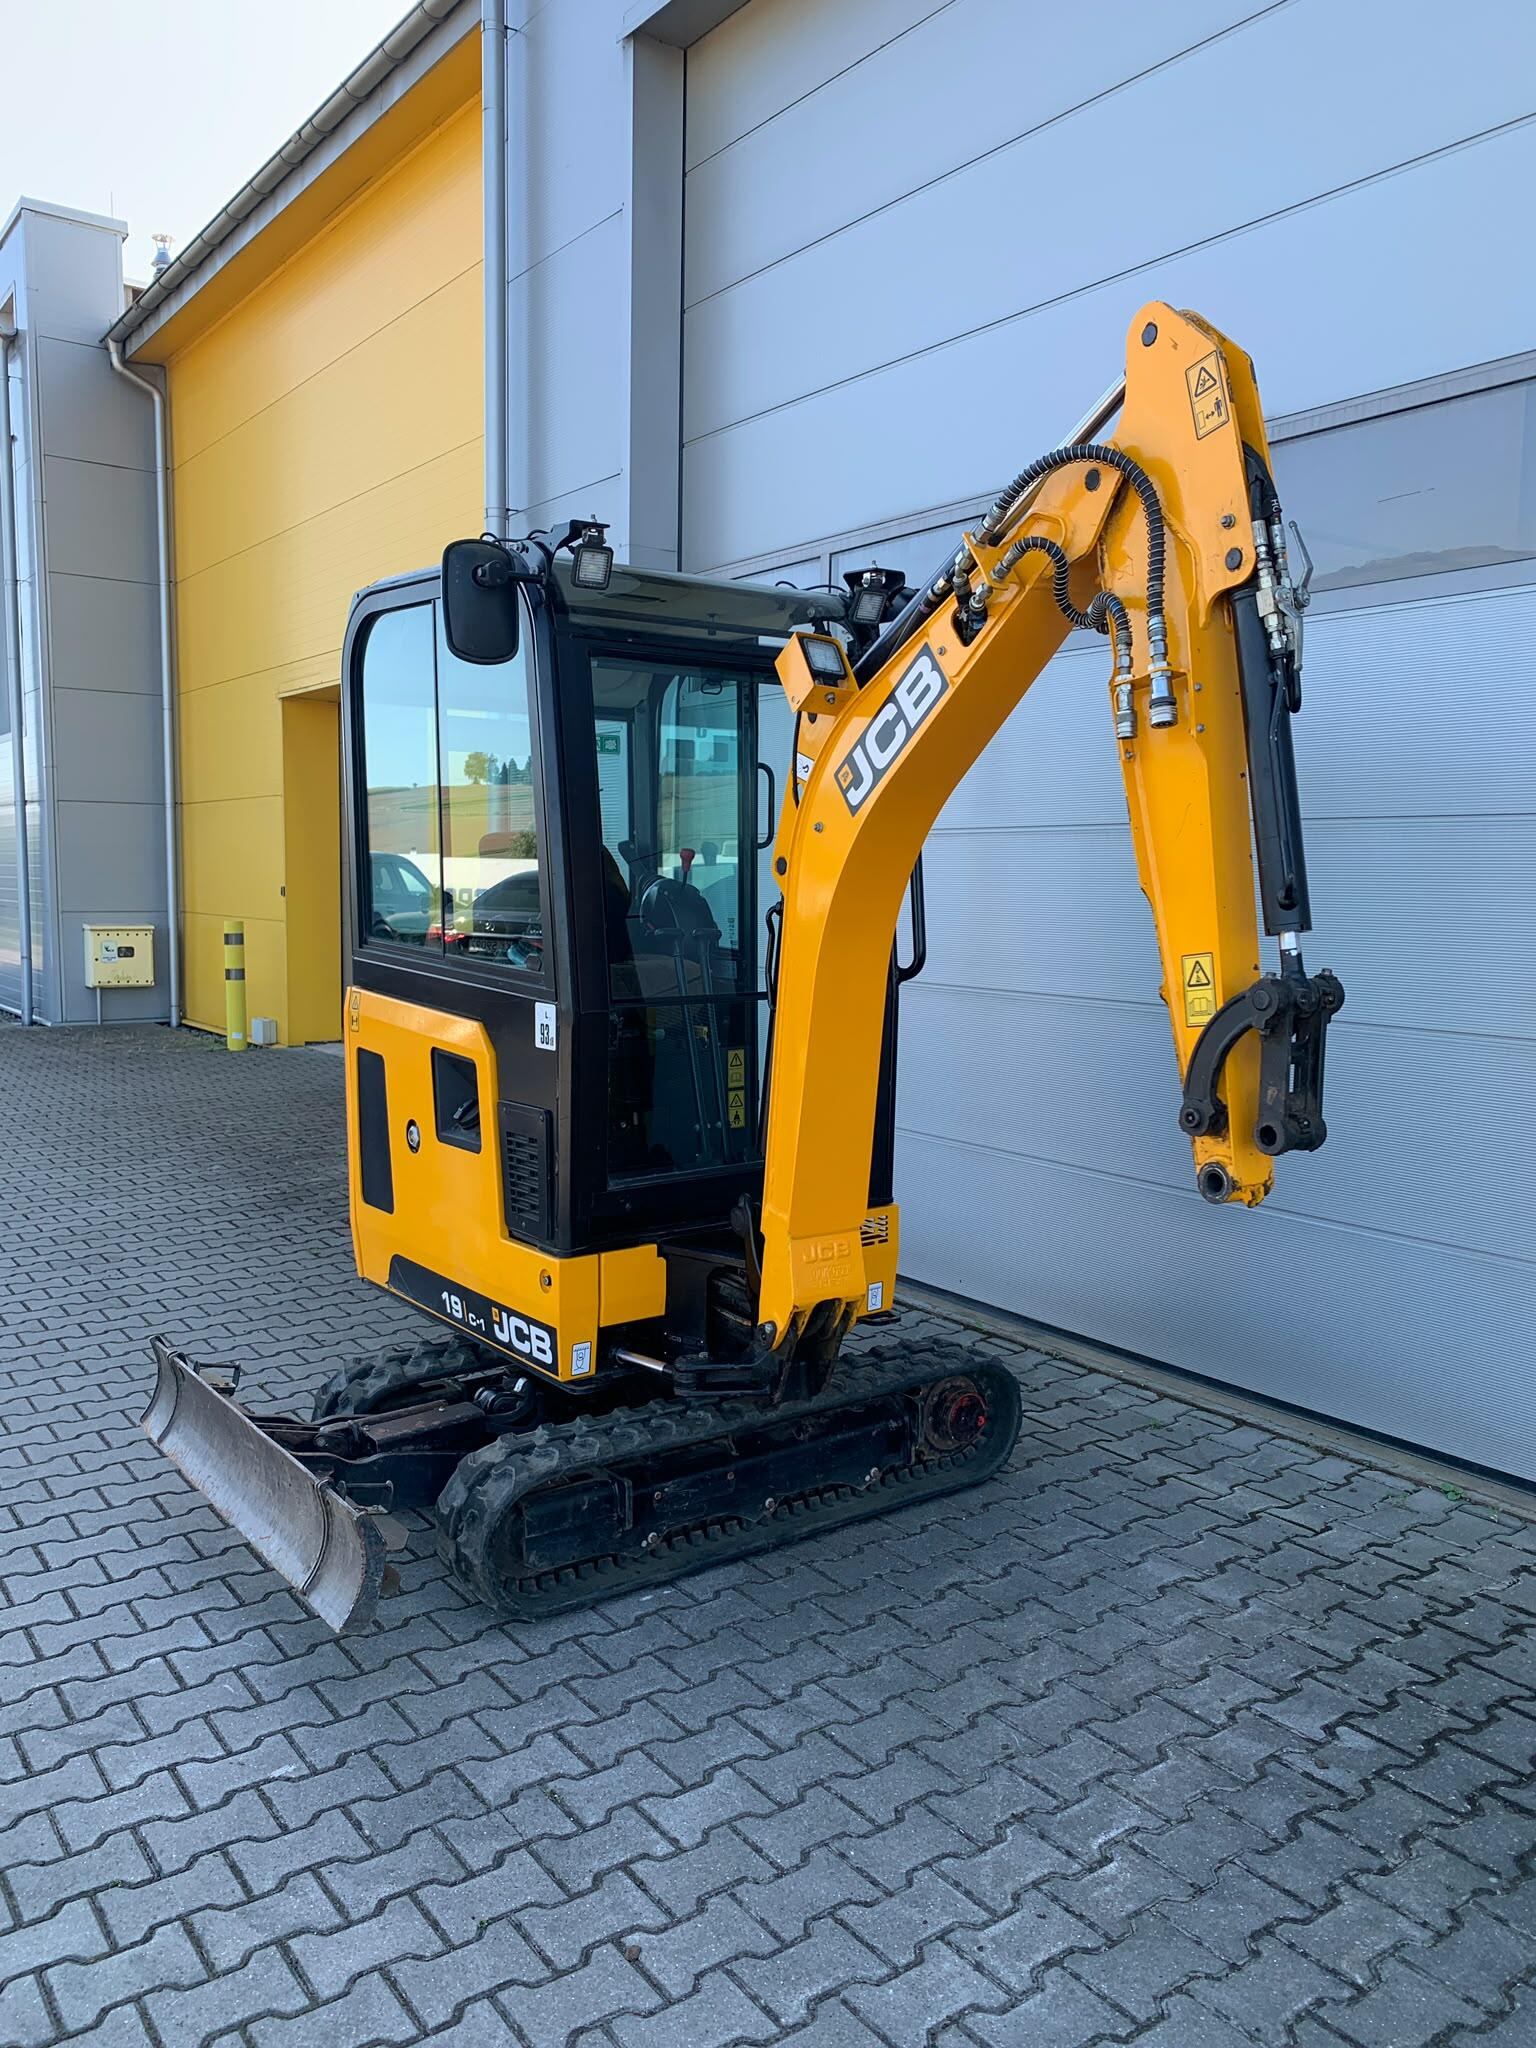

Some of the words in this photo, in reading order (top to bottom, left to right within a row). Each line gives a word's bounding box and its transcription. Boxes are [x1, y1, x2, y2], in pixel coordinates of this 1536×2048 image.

[846, 655, 942, 806] JCB
[540, 1023, 550, 1045] 93
[802, 1240, 851, 1264] JCB
[440, 1290, 463, 1319] 19
[493, 1311, 553, 1364] JCB
